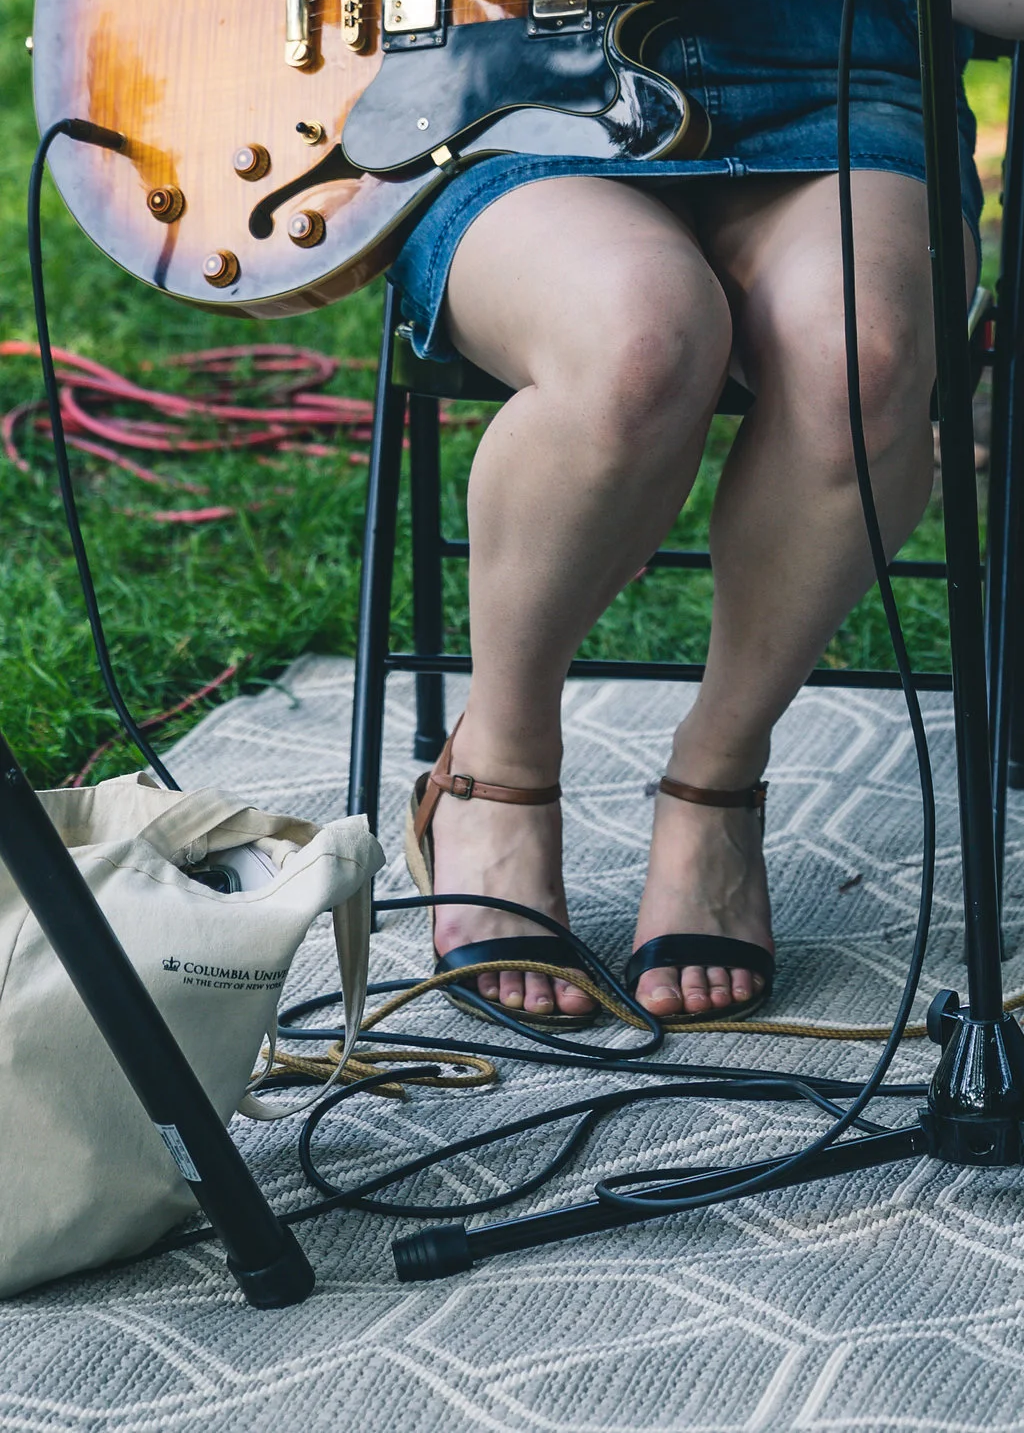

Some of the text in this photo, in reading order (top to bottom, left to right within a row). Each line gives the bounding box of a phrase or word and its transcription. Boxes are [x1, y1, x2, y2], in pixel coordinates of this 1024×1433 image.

[183, 962, 250, 980] COLUMBIA
[196, 978, 211, 987] THE
[213, 981, 232, 989] CITY
[233, 982, 244, 990] OF
